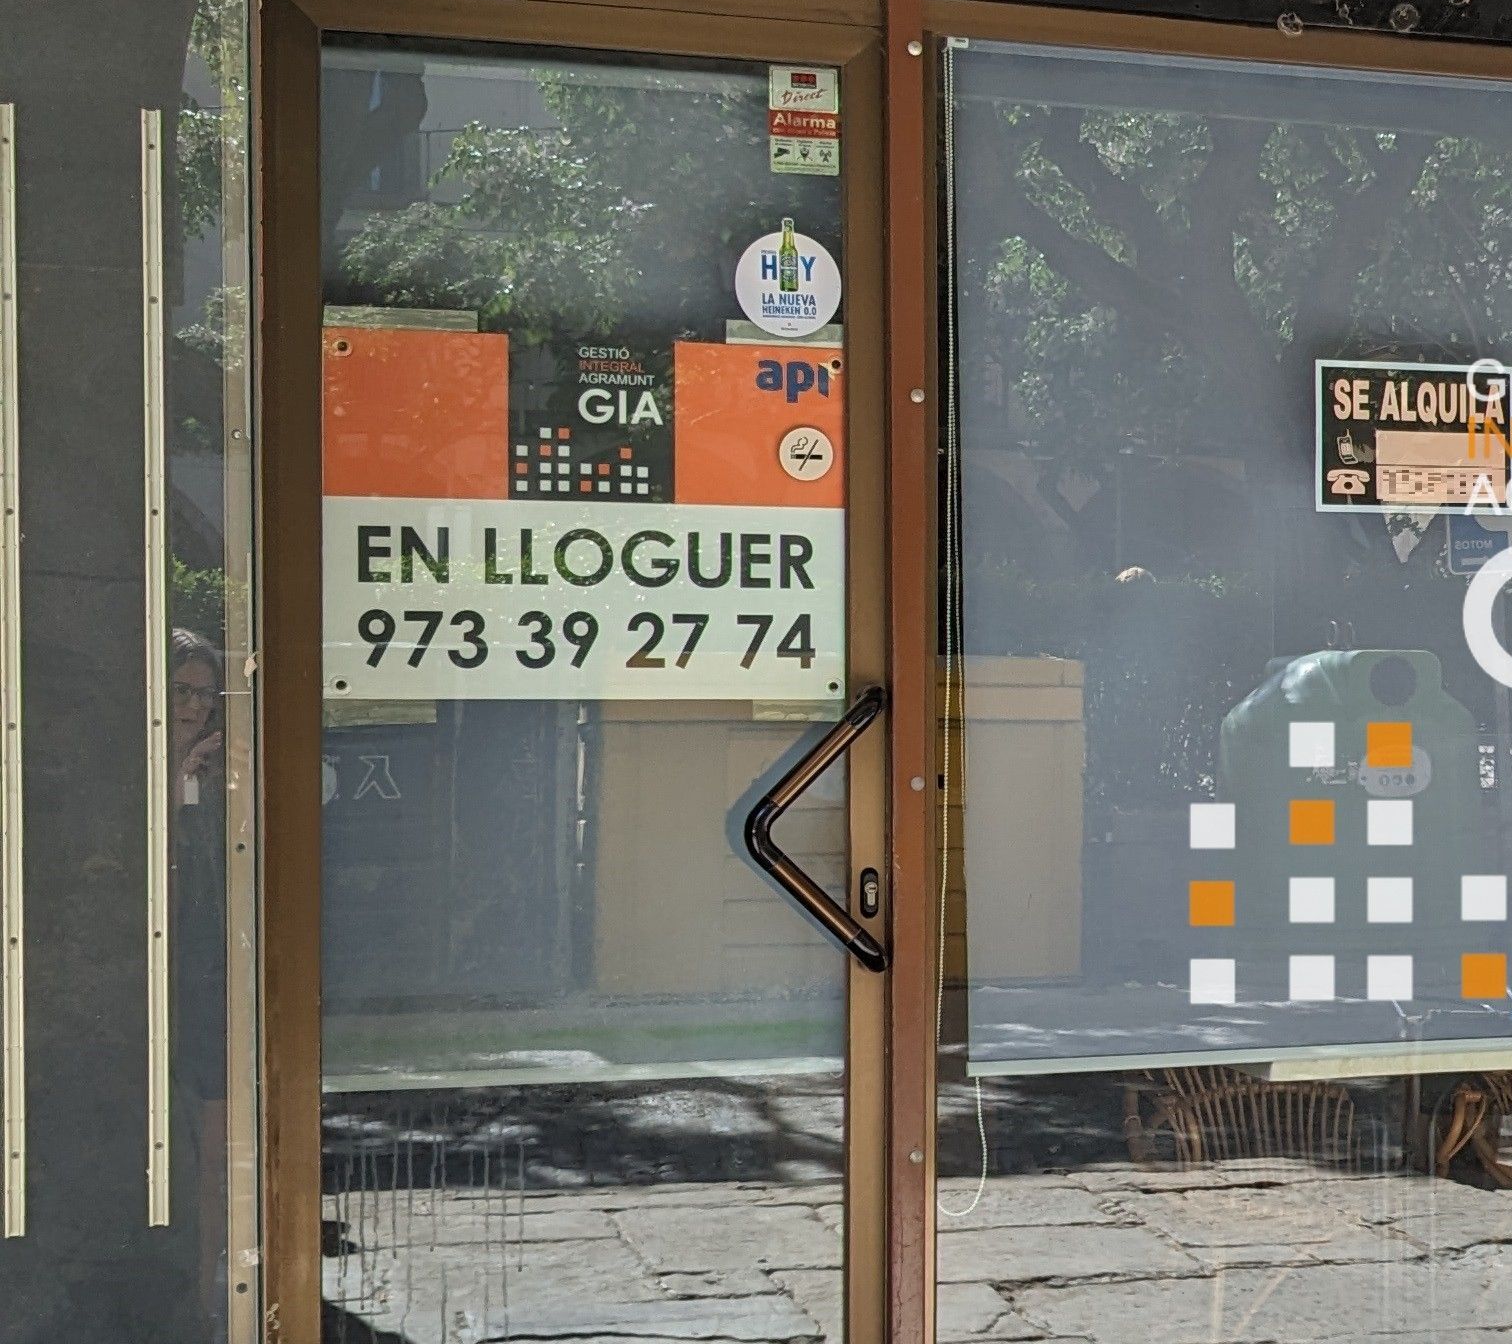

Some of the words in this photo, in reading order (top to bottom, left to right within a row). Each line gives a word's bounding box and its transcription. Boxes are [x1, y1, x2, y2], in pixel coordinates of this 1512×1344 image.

[773, 112, 836, 130] Alarma
[761, 254, 817, 282] HY
[762, 293, 775, 305] LA
[779, 293, 817, 306] NUEVA
[762, 306, 801, 315] HEINEKEN
[803, 307, 817, 316] 0.0
[579, 346, 630, 360] GESTIÓ
[579, 360, 645, 373] INTEGRAL
[579, 373, 655, 386] AGRAMUNT
[578, 388, 664, 425] GIA
[1333, 378, 1371, 422] SE
[1379, 380, 1505, 427] ALQUILA
[357, 525, 450, 584] EN
[484, 527, 815, 590] LLOGUER
[357, 608, 489, 669] 973
[515, 610, 599, 669] 39
[625, 611, 710, 669] 27
[736, 613, 816, 669] 74
